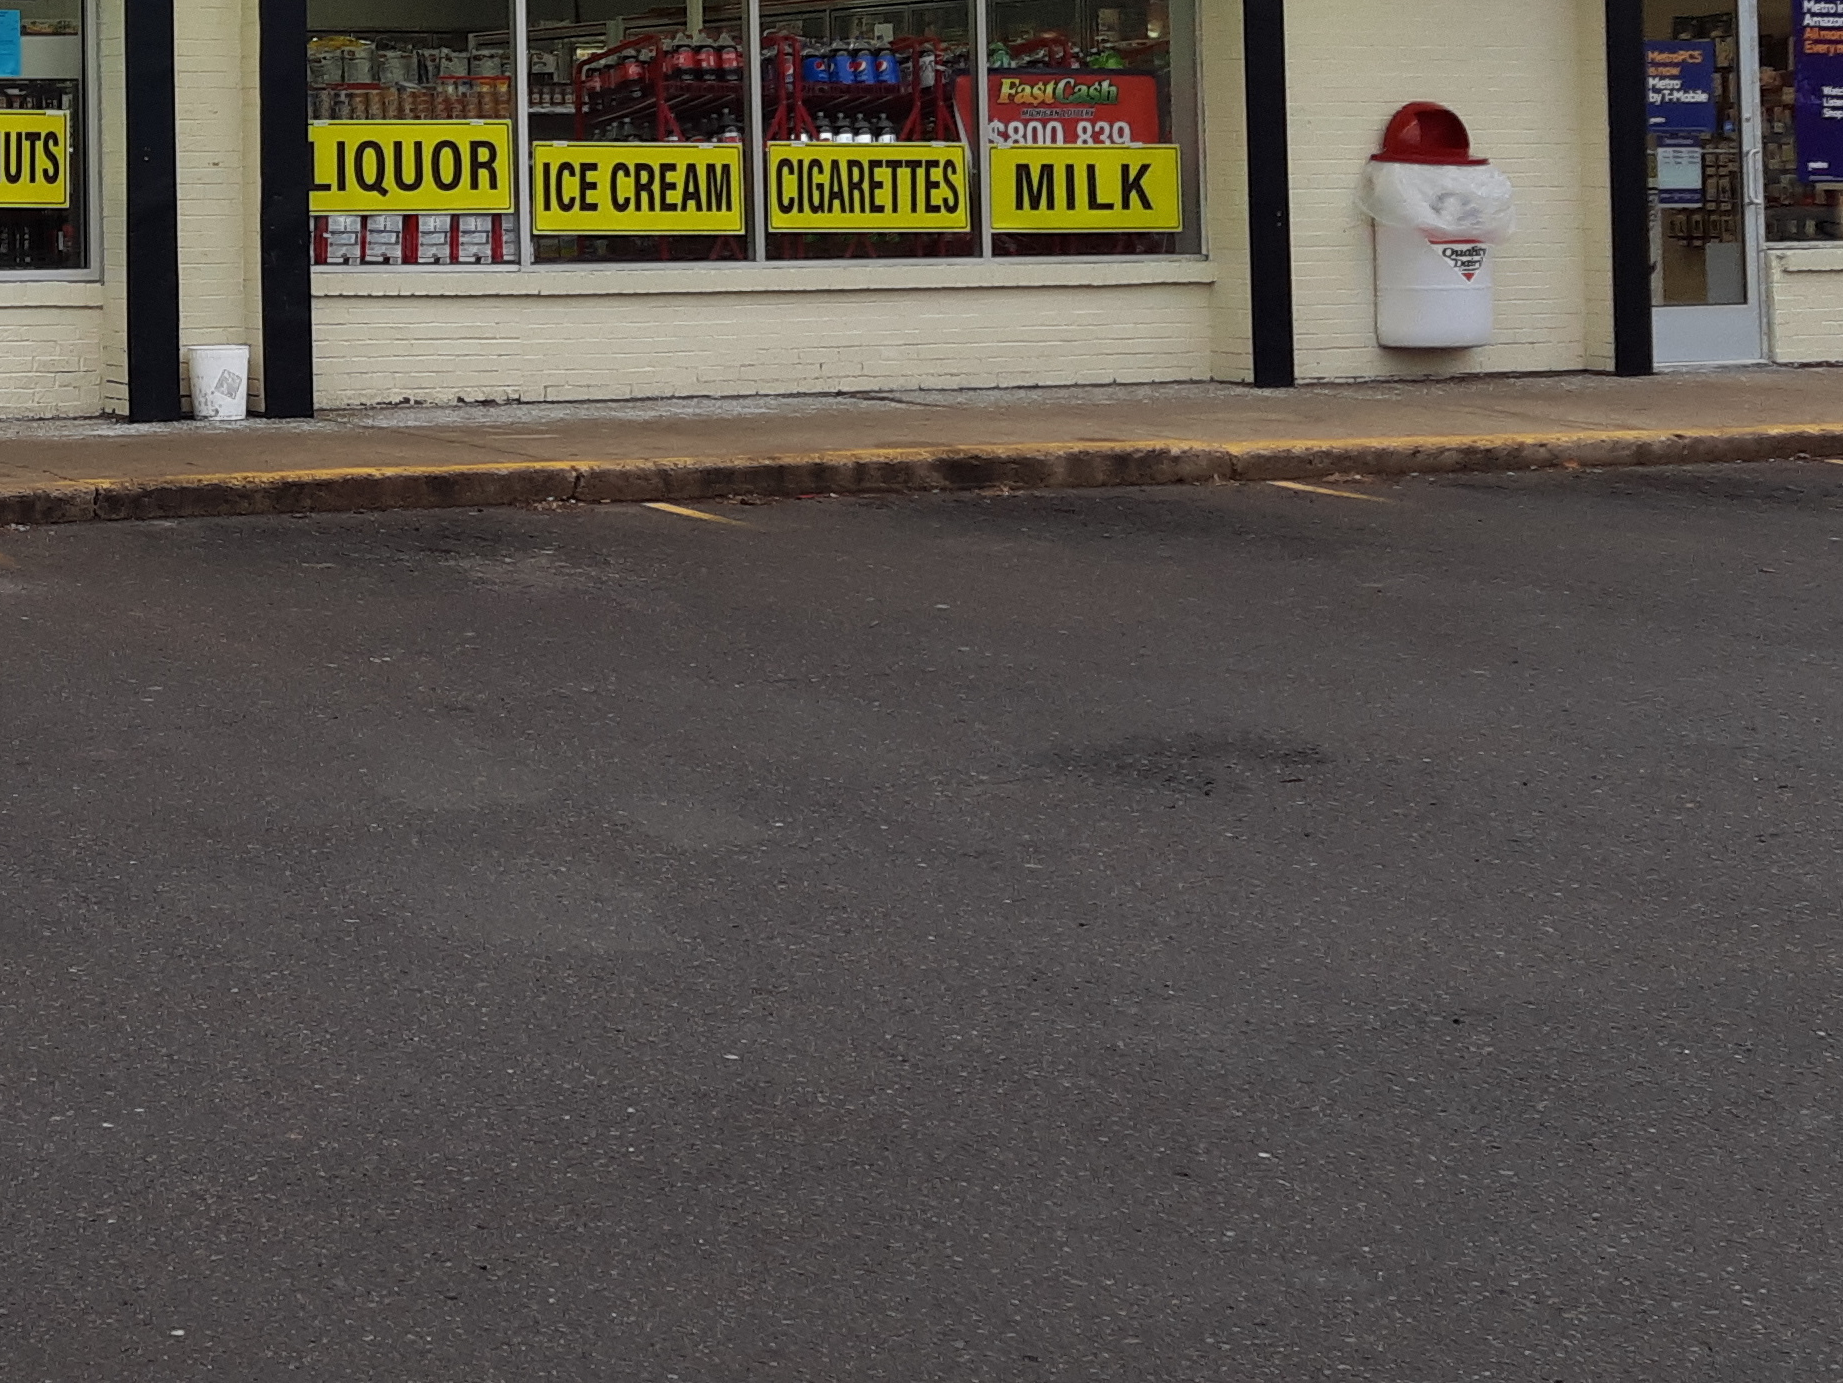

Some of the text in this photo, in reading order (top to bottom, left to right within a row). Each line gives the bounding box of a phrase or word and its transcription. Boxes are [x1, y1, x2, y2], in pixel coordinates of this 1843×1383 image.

[1803, 0, 1837, 14] Metro
[1648, 76, 1683, 89] Metro
[1648, 89, 1710, 106] by T-Mobile
[309, 139, 498, 197] LIQUOR
[542, 160, 733, 214] ICE CREAM
[774, 157, 960, 215] CIGARETTES
[1014, 162, 1154, 213] MILK
